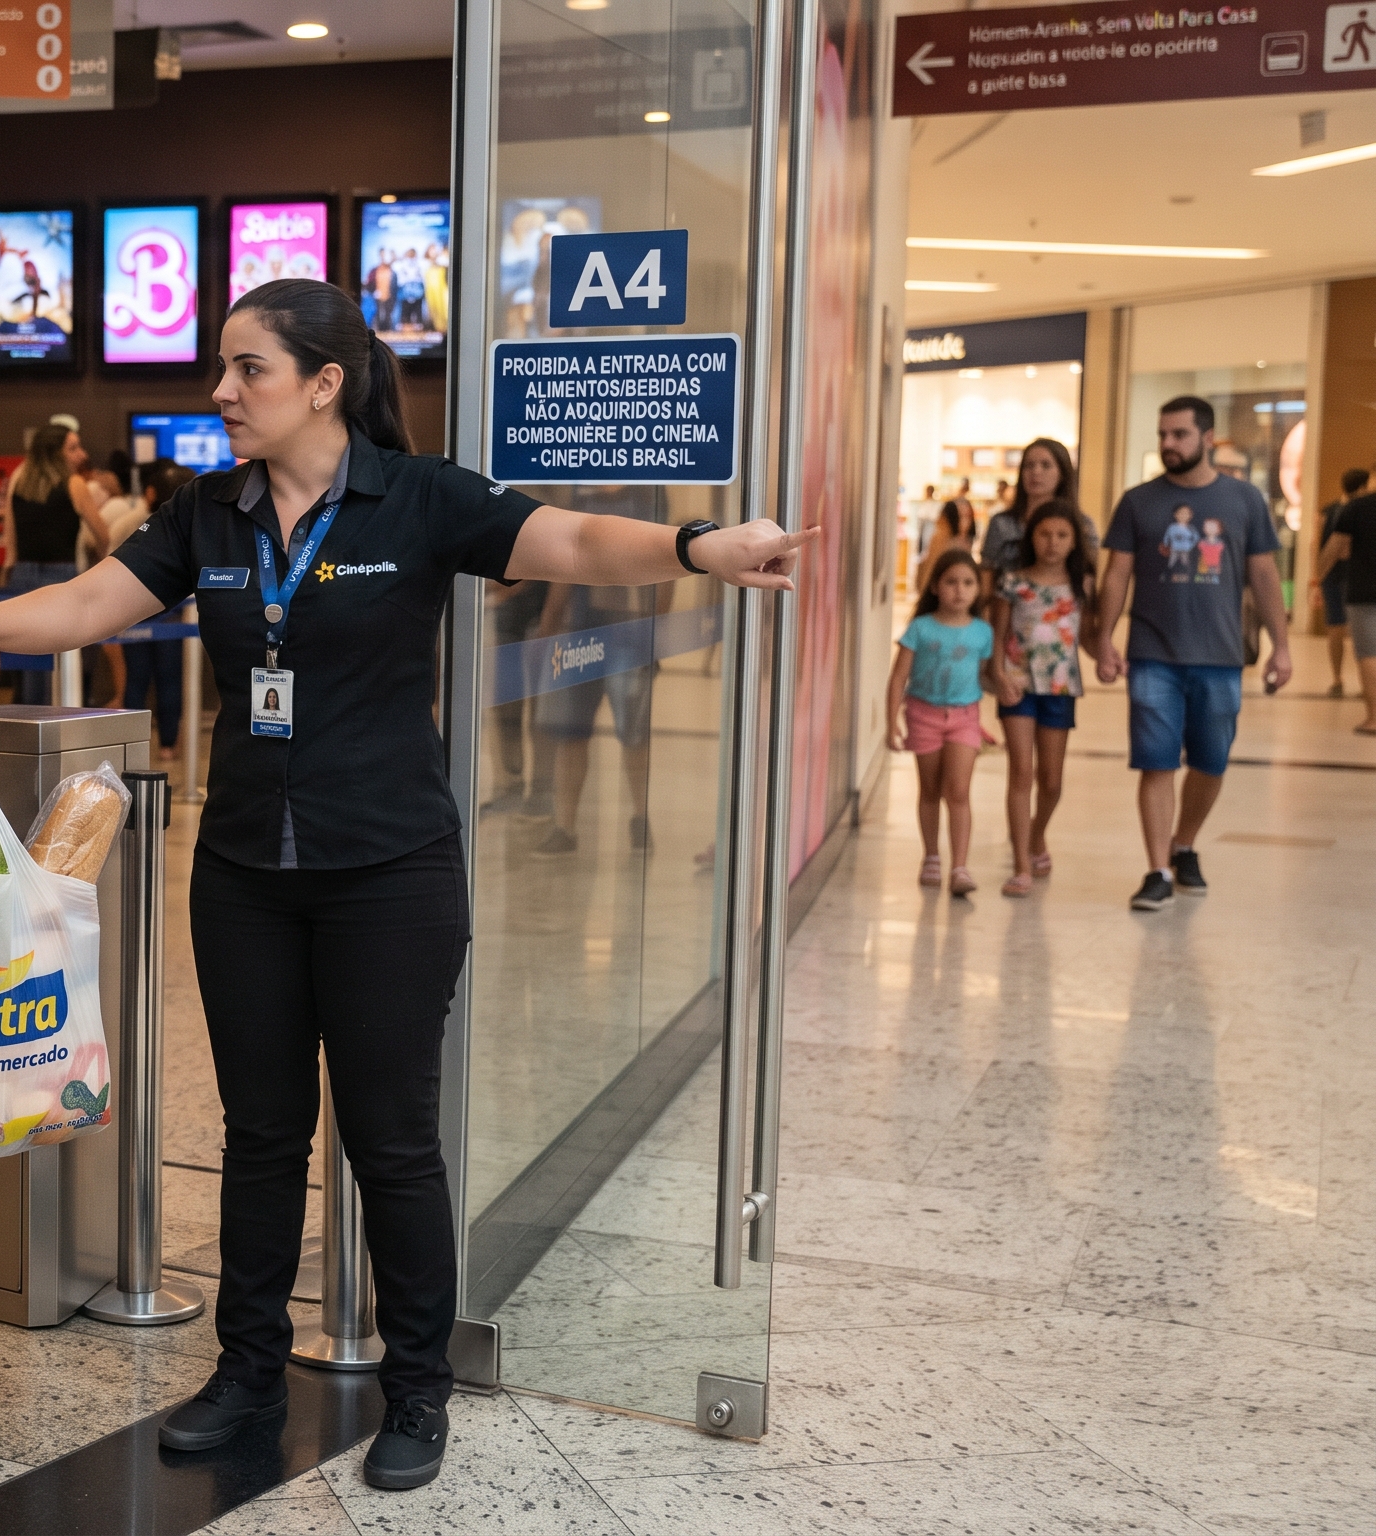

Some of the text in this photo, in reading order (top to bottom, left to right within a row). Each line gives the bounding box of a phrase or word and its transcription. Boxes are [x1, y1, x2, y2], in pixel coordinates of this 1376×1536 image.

[568, 248, 666, 311] A4
[502, 352, 727, 376] PROIBIDA A ENTRADA COM
[525, 377, 701, 399] ALIMENTOS/BEBIDAS
[525, 399, 699, 421] NÃO ADQUIRIDOS NA
[622, 425, 647, 443] DO
[652, 424, 720, 443] CINEMA
[632, 448, 696, 468] BRASIL
